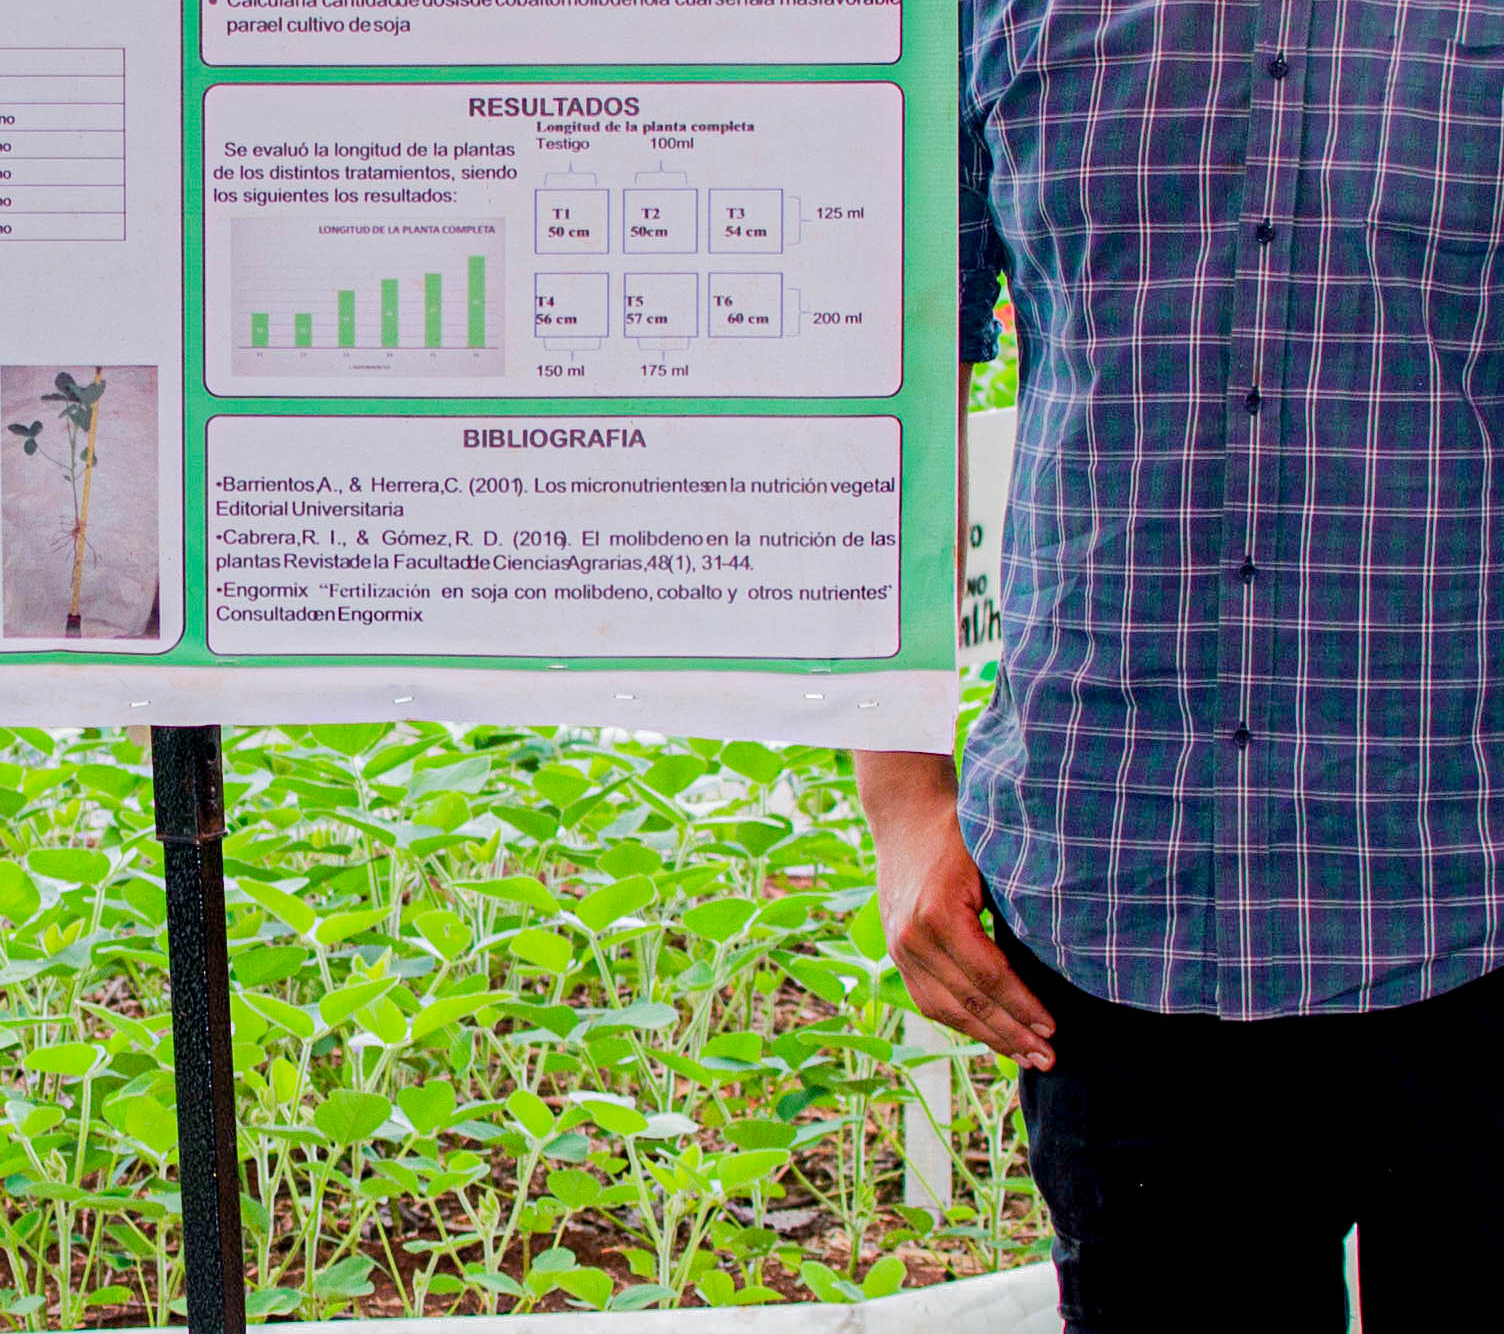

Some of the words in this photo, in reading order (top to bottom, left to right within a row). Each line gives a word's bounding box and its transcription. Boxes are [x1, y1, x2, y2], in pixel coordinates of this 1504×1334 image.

[469, 97, 639, 117] RESULTADOS
[537, 121, 600, 135] Longitud
[605, 121, 621, 132] de
[626, 121, 637, 132] la
[643, 121, 686, 135] planta
[691, 121, 754, 135] completa
[536, 138, 589, 152] Testigo
[651, 137, 693, 149] 100ml
[552, 209, 569, 219] T1
[641, 208, 660, 219] T2
[727, 208, 745, 219] T3
[817, 207, 842, 219] 125
[848, 207, 864, 218] ml
[319, 224, 370, 236] LONGITUD
[373, 224, 385, 236] DE
[388, 224, 400, 236] LA
[403, 224, 440, 236] PLANTA
[442, 224, 496, 236] COMPLETA
[549, 226, 564, 237] 50
[569, 229, 589, 237] cm
[726, 226, 741, 237] 54
[746, 229, 767, 237] cm
[537, 296, 555, 307] T4
[626, 296, 644, 307] T5
[713, 296, 733, 306] T6
[536, 313, 552, 325] 56
[556, 315, 577, 325] cm
[626, 313, 642, 325] 57
[647, 315, 668, 325] cm
[728, 313, 744, 324] 60
[748, 316, 769, 324] cm
[814, 312, 840, 324] 200
[845, 312, 862, 323] ml
[537, 365, 563, 377] 150
[568, 365, 584, 376] ml
[641, 365, 667, 376] 175
[672, 365, 688, 376] ml
[464, 429, 646, 448] BIBLIOGRAFIA
[442, 587, 463, 598] en
[471, 584, 508, 603] soja
[515, 588, 546, 599] con
[555, 584, 653, 601] molibdeno,
[657, 584, 722, 600] cobalto
[727, 588, 737, 604] y
[748, 585, 793, 600] otros
